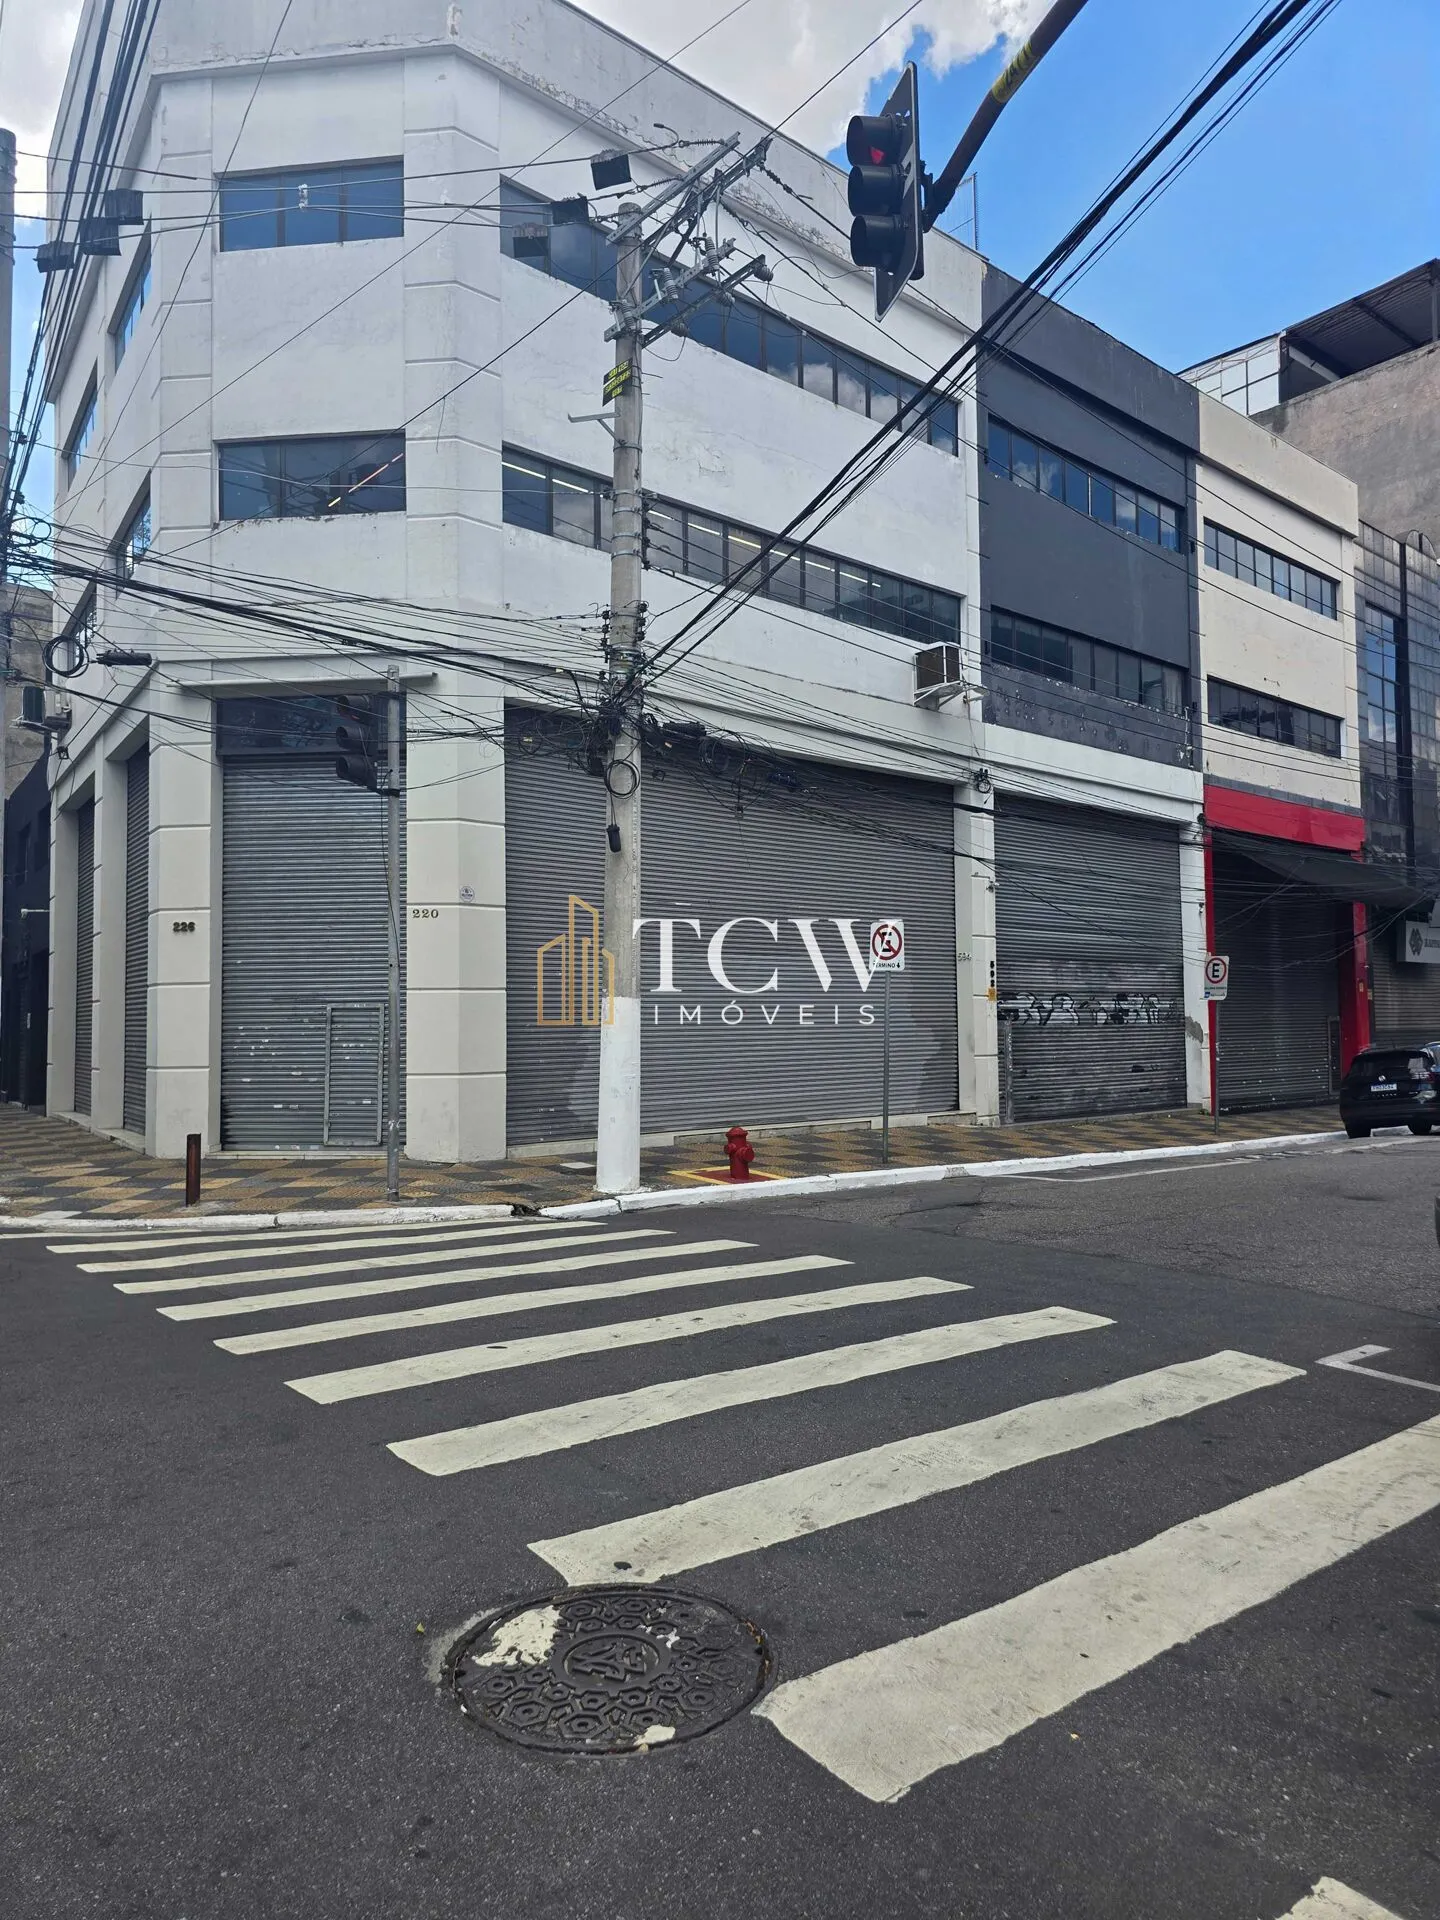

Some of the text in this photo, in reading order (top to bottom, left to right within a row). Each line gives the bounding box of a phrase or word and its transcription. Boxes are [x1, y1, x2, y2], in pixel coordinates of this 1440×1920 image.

[412, 909, 439, 919] 220
[173, 921, 196, 933] 226
[1211, 963, 1221, 978] E
